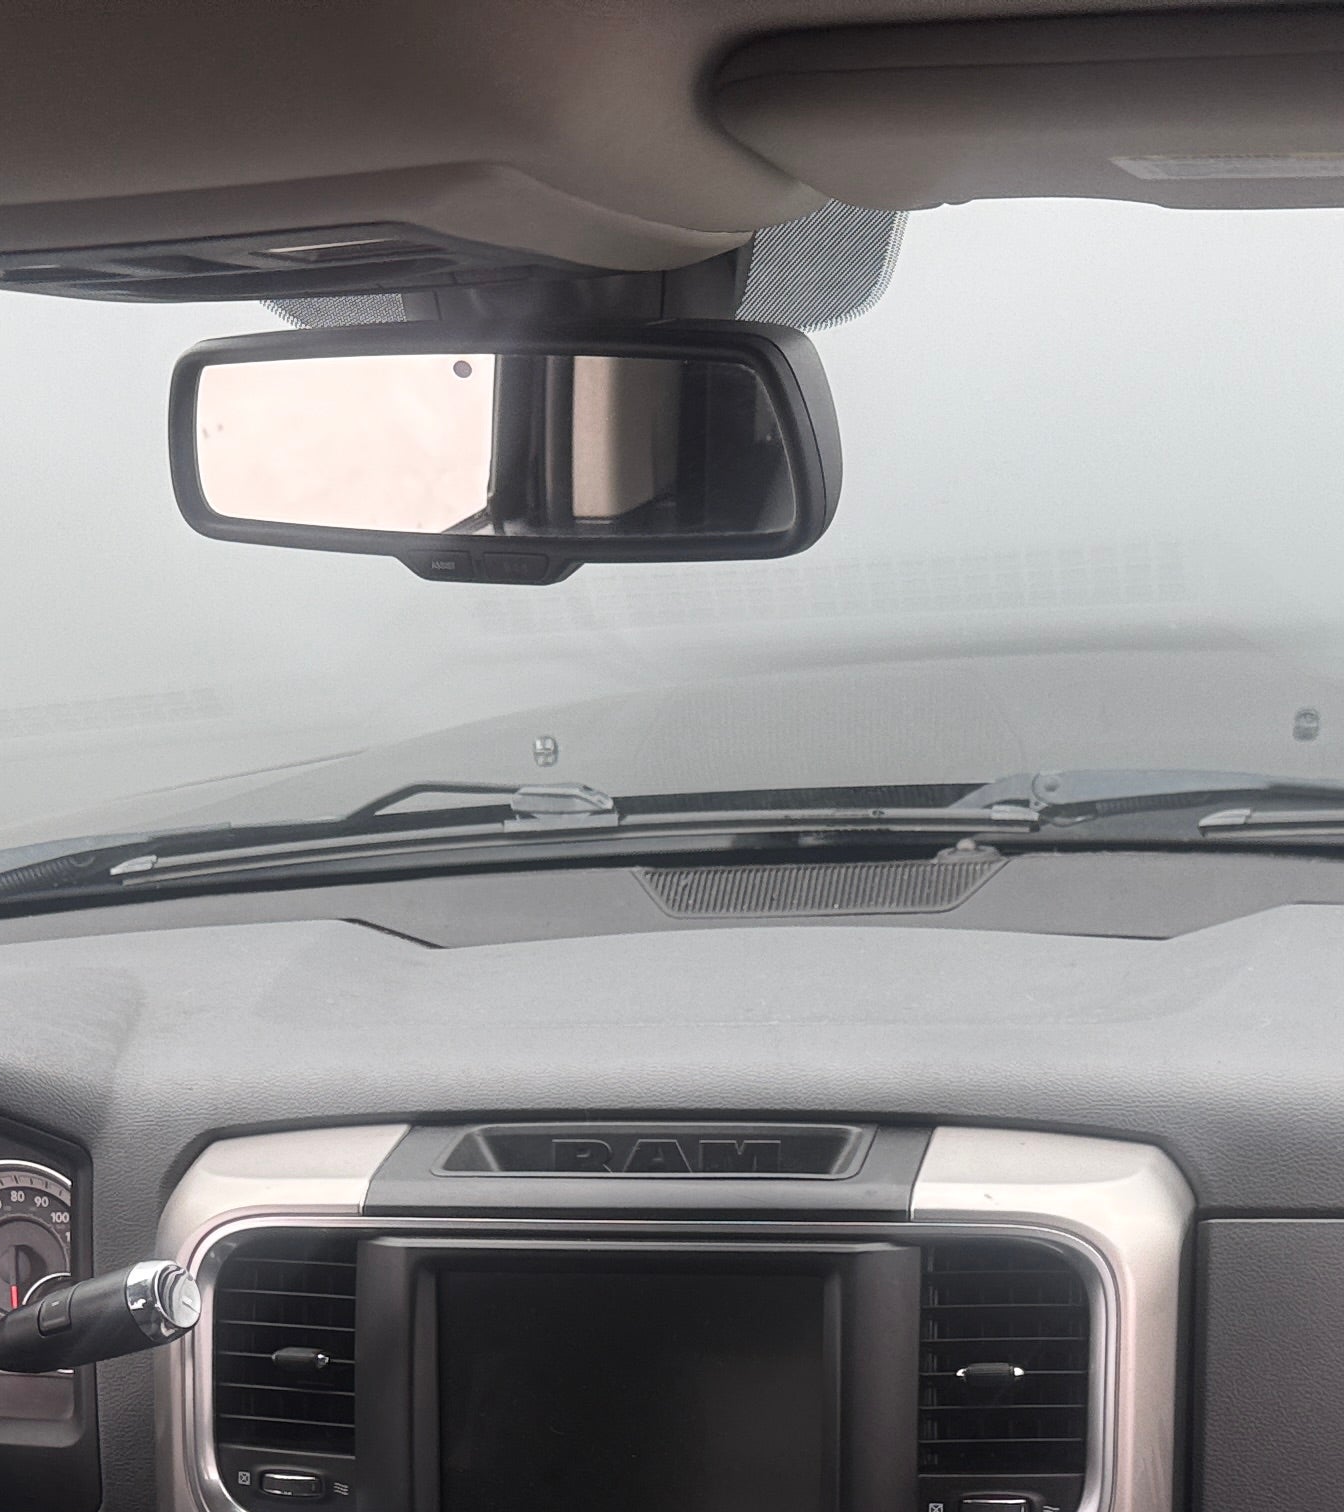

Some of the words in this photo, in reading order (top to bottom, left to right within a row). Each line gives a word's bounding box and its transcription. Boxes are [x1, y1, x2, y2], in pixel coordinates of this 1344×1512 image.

[552, 1138, 781, 1174] RAM
[10, 1190, 25, 1203] 80
[34, 1196, 49, 1208] 90
[50, 1212, 70, 1223] 100
